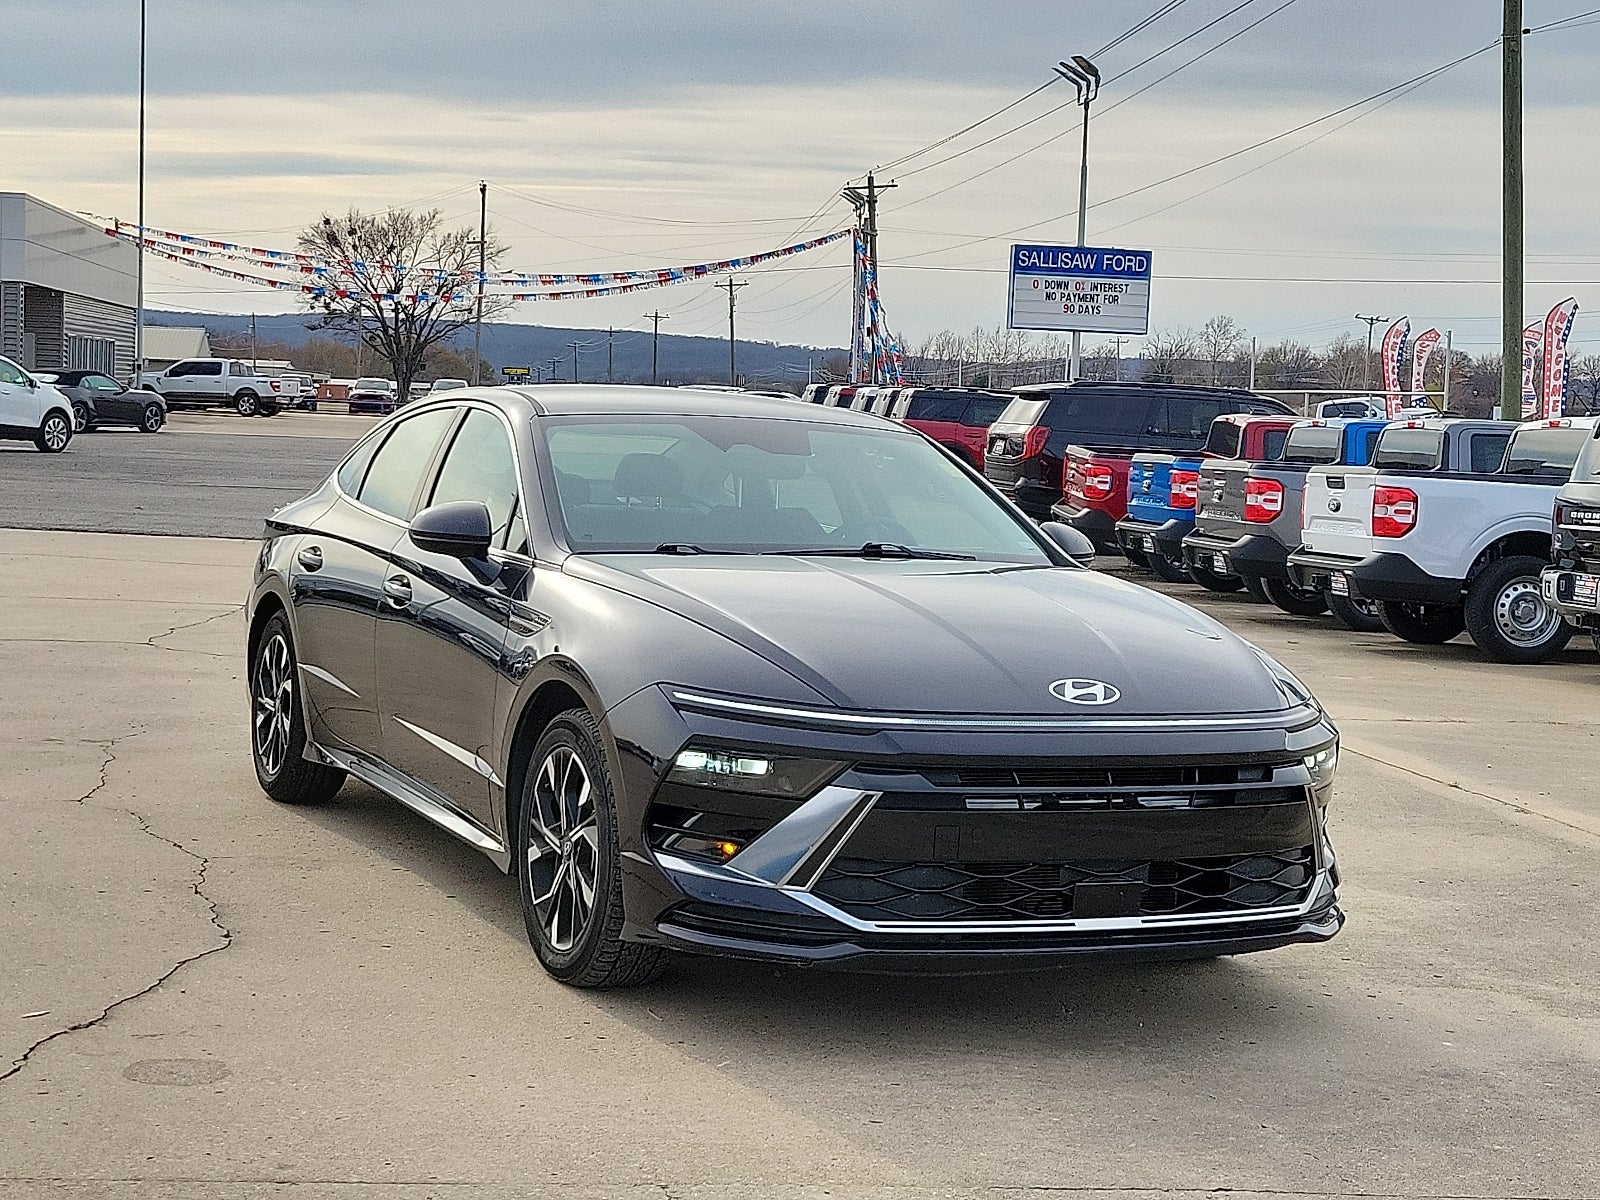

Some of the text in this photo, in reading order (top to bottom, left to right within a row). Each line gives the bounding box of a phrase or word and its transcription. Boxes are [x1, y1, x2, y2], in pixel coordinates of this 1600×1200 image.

[1018, 250, 1147, 272] SALLISAW FORD
[1032, 279, 1039, 289] 0
[1044, 280, 1069, 290] DOWN
[1090, 282, 1129, 293] INTEREST
[1045, 292, 1119, 304] NO PAYMENT FOR
[1063, 304, 1101, 315] 90 DAYS
[1551, 311, 1569, 413] WELCOME
